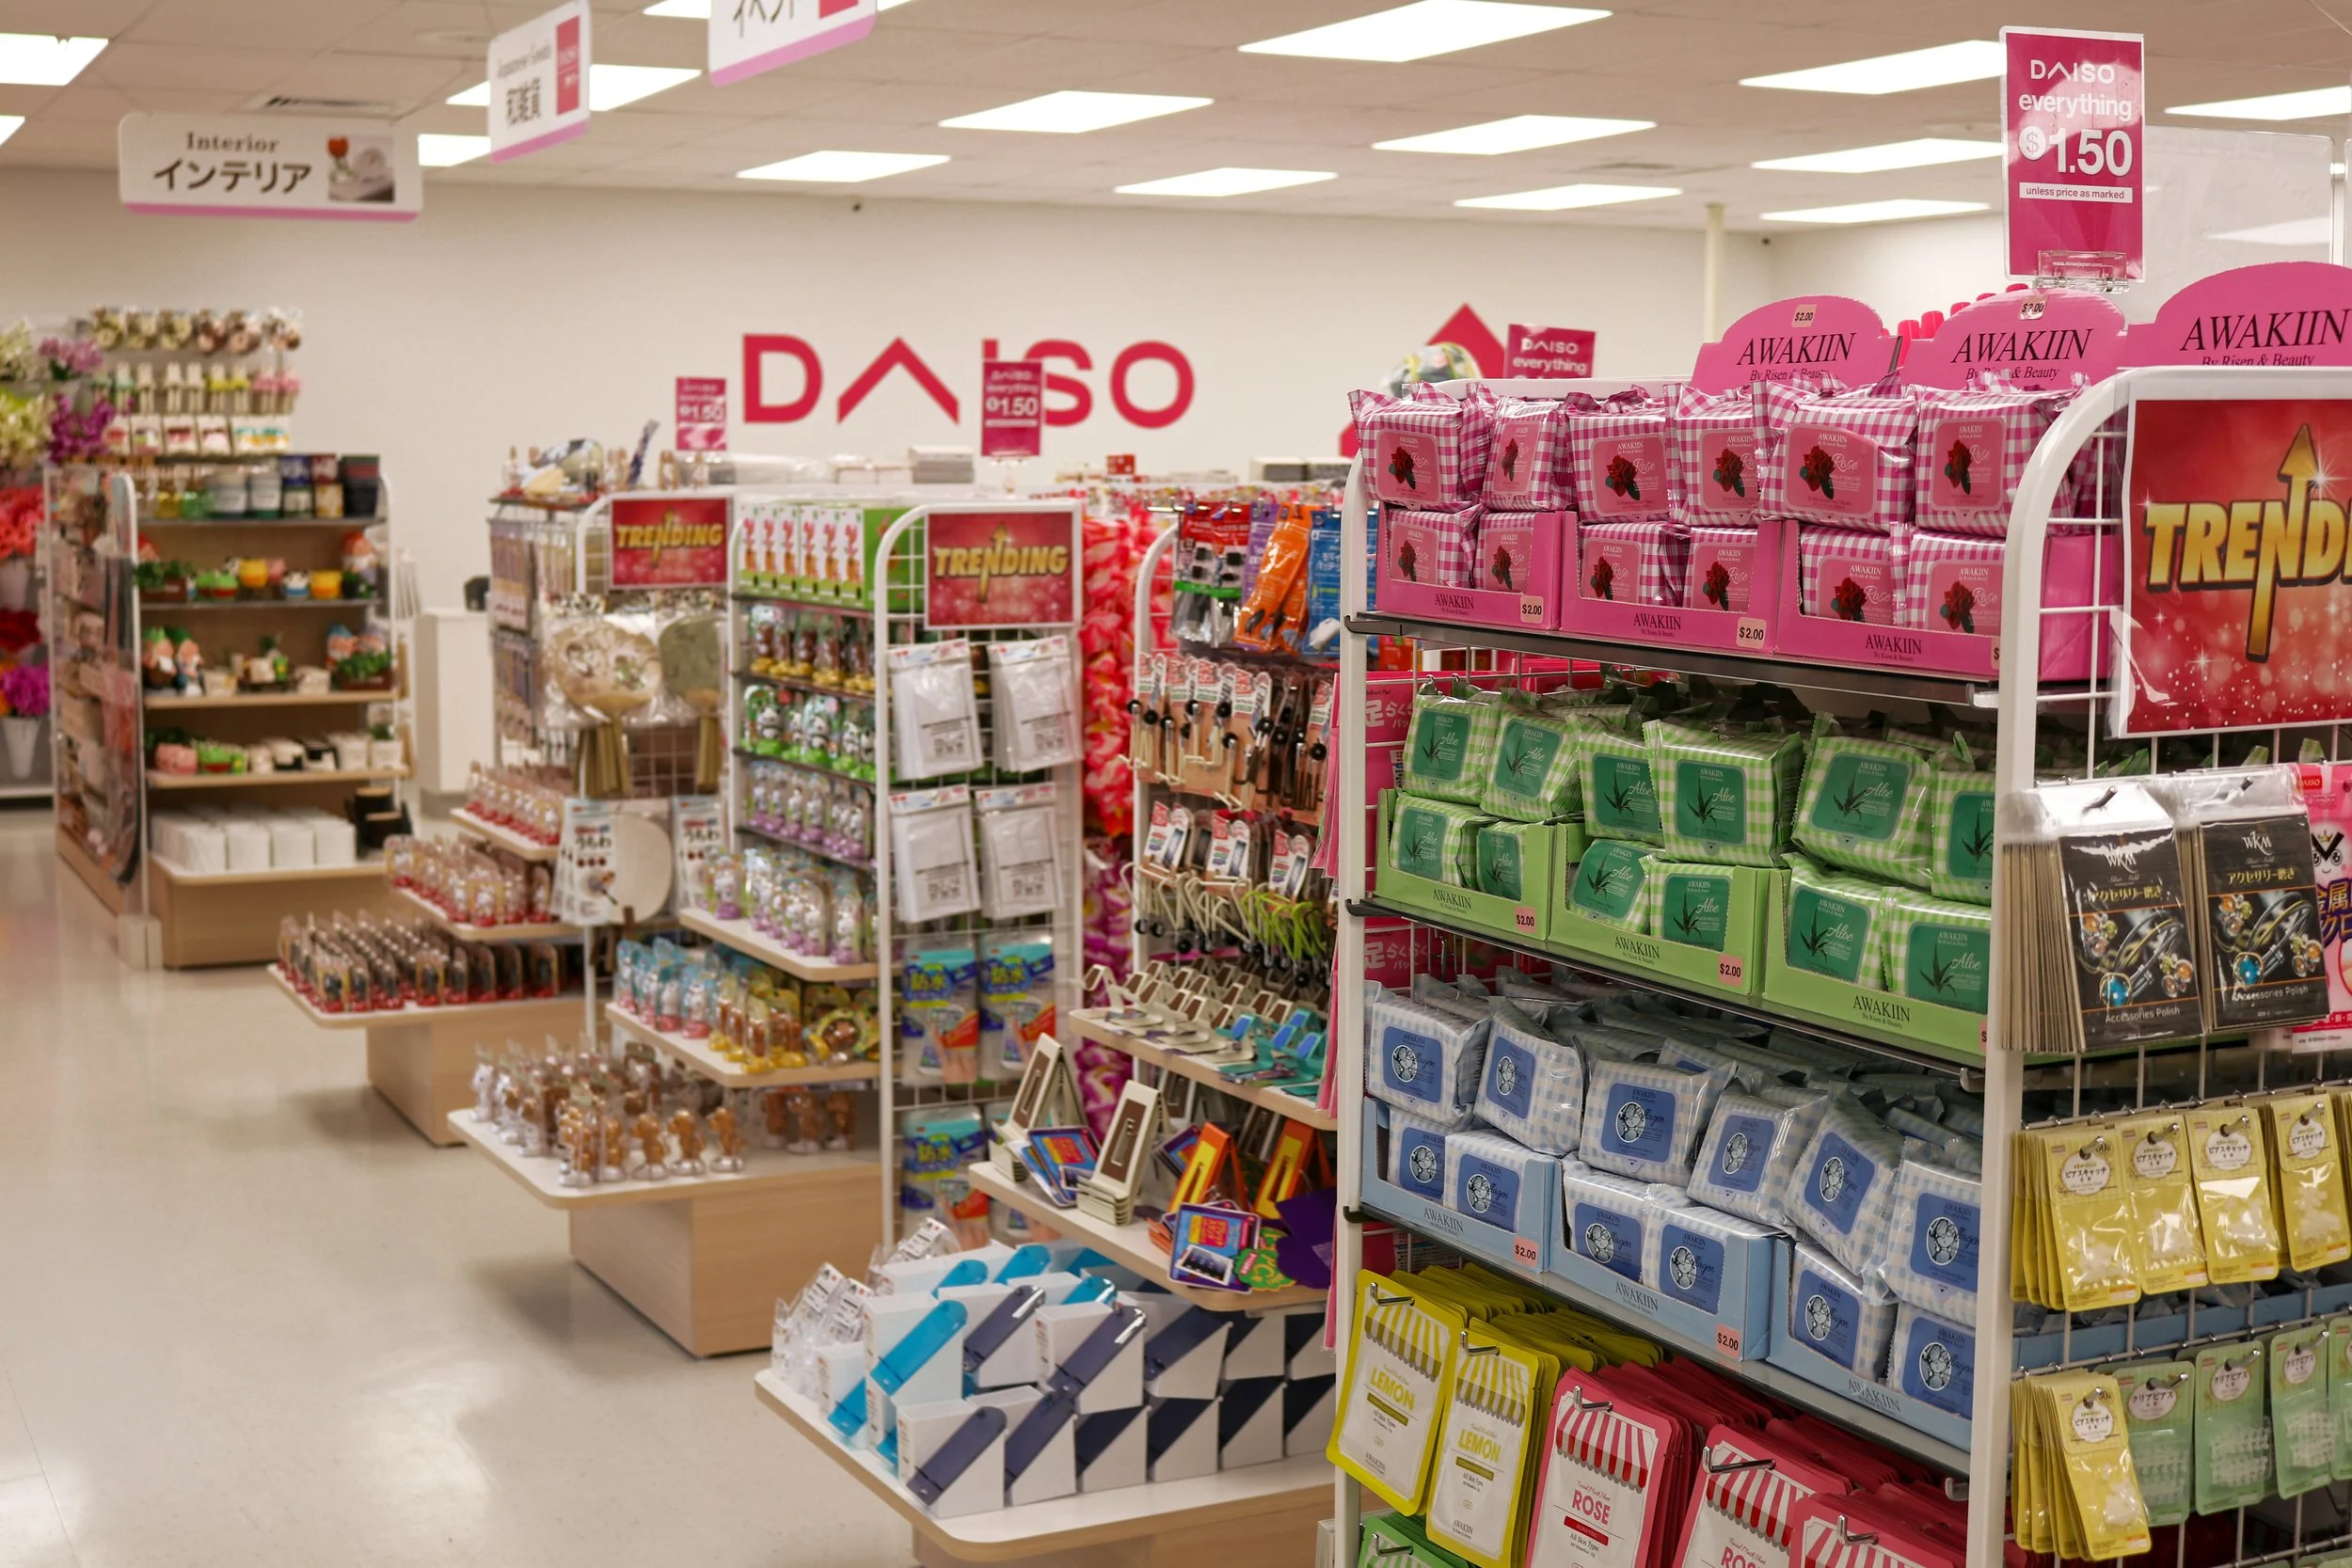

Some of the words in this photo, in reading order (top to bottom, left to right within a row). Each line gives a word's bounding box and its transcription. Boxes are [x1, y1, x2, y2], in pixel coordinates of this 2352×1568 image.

[2030, 59, 2115, 85] DAISO
[2018, 93, 2133, 121] everything
[186, 132, 279, 153] Interior
[2018, 125, 2133, 177] $1.50
[153, 158, 312, 193] インテリア
[2026, 187, 2055, 196] unless
[2056, 189, 2078, 198] price
[2091, 190, 2125, 199] marked
[1794, 312, 1814, 322] $2.00
[2179, 309, 2352, 351] AWAKIIN
[1521, 338, 1579, 354] DAISO
[1736, 332, 1857, 366] AWAKIIN
[1950, 328, 2093, 363] AWAKIIN
[1513, 357, 1587, 375] everything
[1765, 369, 1788, 380] Risen
[2010, 367, 2021, 378] &
[2024, 366, 2060, 381] Beauty
[742, 333, 1196, 430] DASO
[1818, 434, 1847, 444] AWAKIIN
[1632, 458, 1655, 474] Rose
[1832, 453, 1859, 473] Rose
[615, 523, 723, 548] TRENDING
[933, 546, 1068, 578] TRENDING
[1612, 562, 1629, 579] Rose
[1850, 564, 1882, 575] AWAKIIN
[1727, 566, 1748, 585] Rose
[1435, 594, 1474, 610] AWAKIIN
[1864, 585, 1891, 605] Rose
[1973, 587, 1998, 607] Rose
[1522, 604, 1542, 615] $2.00
[1633, 612, 1681, 630] AWAKIIN
[1739, 626, 1764, 641] $2.00
[1866, 634, 1922, 655] AWAKIIN
[1439, 732, 1458, 746] Aloe
[1525, 747, 1545, 761] Aloe
[1628, 781, 1652, 796] Aloe
[1711, 787, 1736, 802] Aloe
[1866, 782, 1893, 799] Aloe
[1422, 832, 1438, 845] Aloe
[1611, 866, 1633, 880] Aloe
[1433, 888, 1471, 910] AWAKIIN
[1696, 898, 1719, 914] Aloe
[1516, 914, 1534, 927] $2.00
[1827, 922, 1853, 942] Aloe
[1614, 936, 1661, 959] AWAKIIN
[1950, 952, 1981, 971] Aloe
[1720, 964, 1741, 978] $2.00
[2285, 986, 2309, 996] Polish
[1853, 995, 1911, 1022] AWAKIIN
[2105, 1011, 2154, 1024] Accessories
[2155, 1007, 2180, 1017] Polish
[2137, 1151, 2174, 1163] ピアスキャッチ
[2208, 1145, 2249, 1154] ピアスキャッチ
[2065, 1166, 2106, 1179] ピアスキャッチ
[1423, 1207, 1464, 1232] AWAKIIN
[1515, 1244, 1536, 1260] $2.00
[1615, 1281, 1659, 1312] AWAKIIN
[1717, 1333, 1739, 1351] $2.00
[1370, 1367, 1416, 1411] LEMON
[1848, 1378, 1900, 1412] AWAKIIN
[2133, 1391, 2174, 1402] クリアピアス
[1458, 1429, 1502, 1464] LEMON
[1572, 1489, 1611, 1526] ROSE
[1578, 1536, 1587, 1544] Skin
[1588, 1541, 1598, 1551] Types
[1721, 1545, 1761, 1568] ROS
